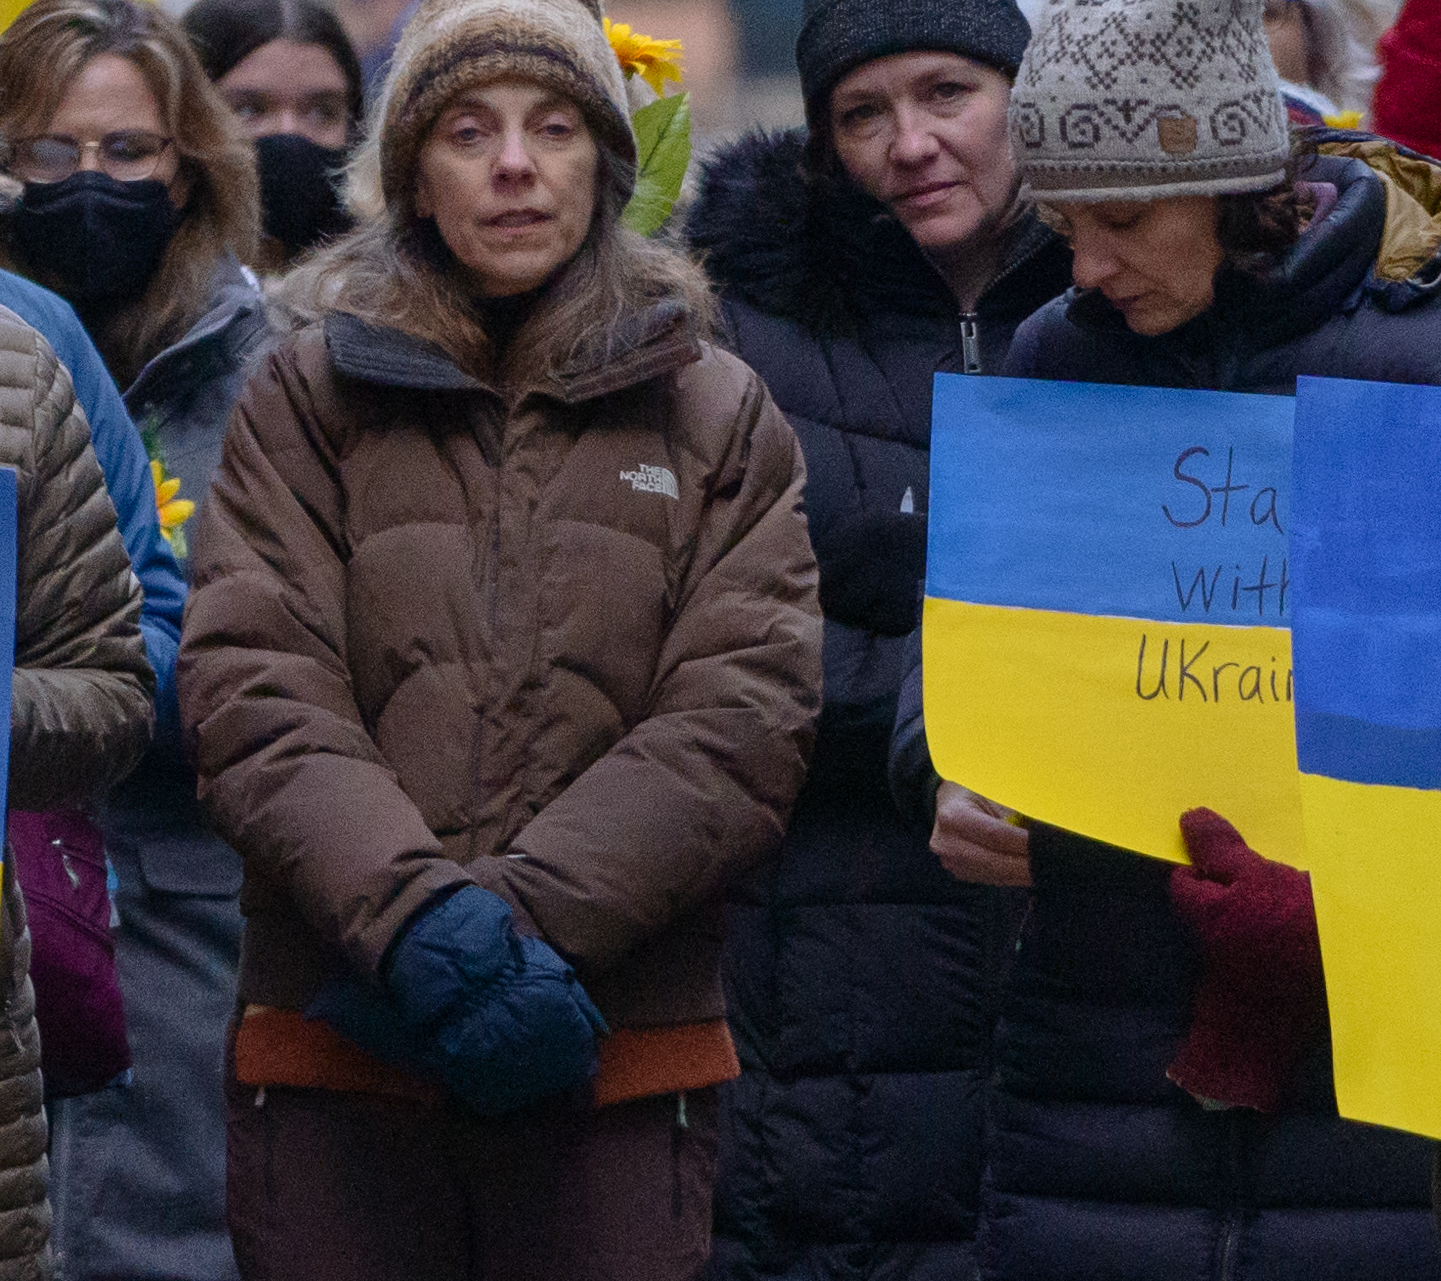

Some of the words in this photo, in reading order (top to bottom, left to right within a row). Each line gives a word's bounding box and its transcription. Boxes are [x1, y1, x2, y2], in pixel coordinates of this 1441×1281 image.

[638, 463, 663, 476] THE
[619, 470, 663, 485] NORTH
[632, 480, 664, 493] FACE
[1161, 446, 1284, 534] Sta
